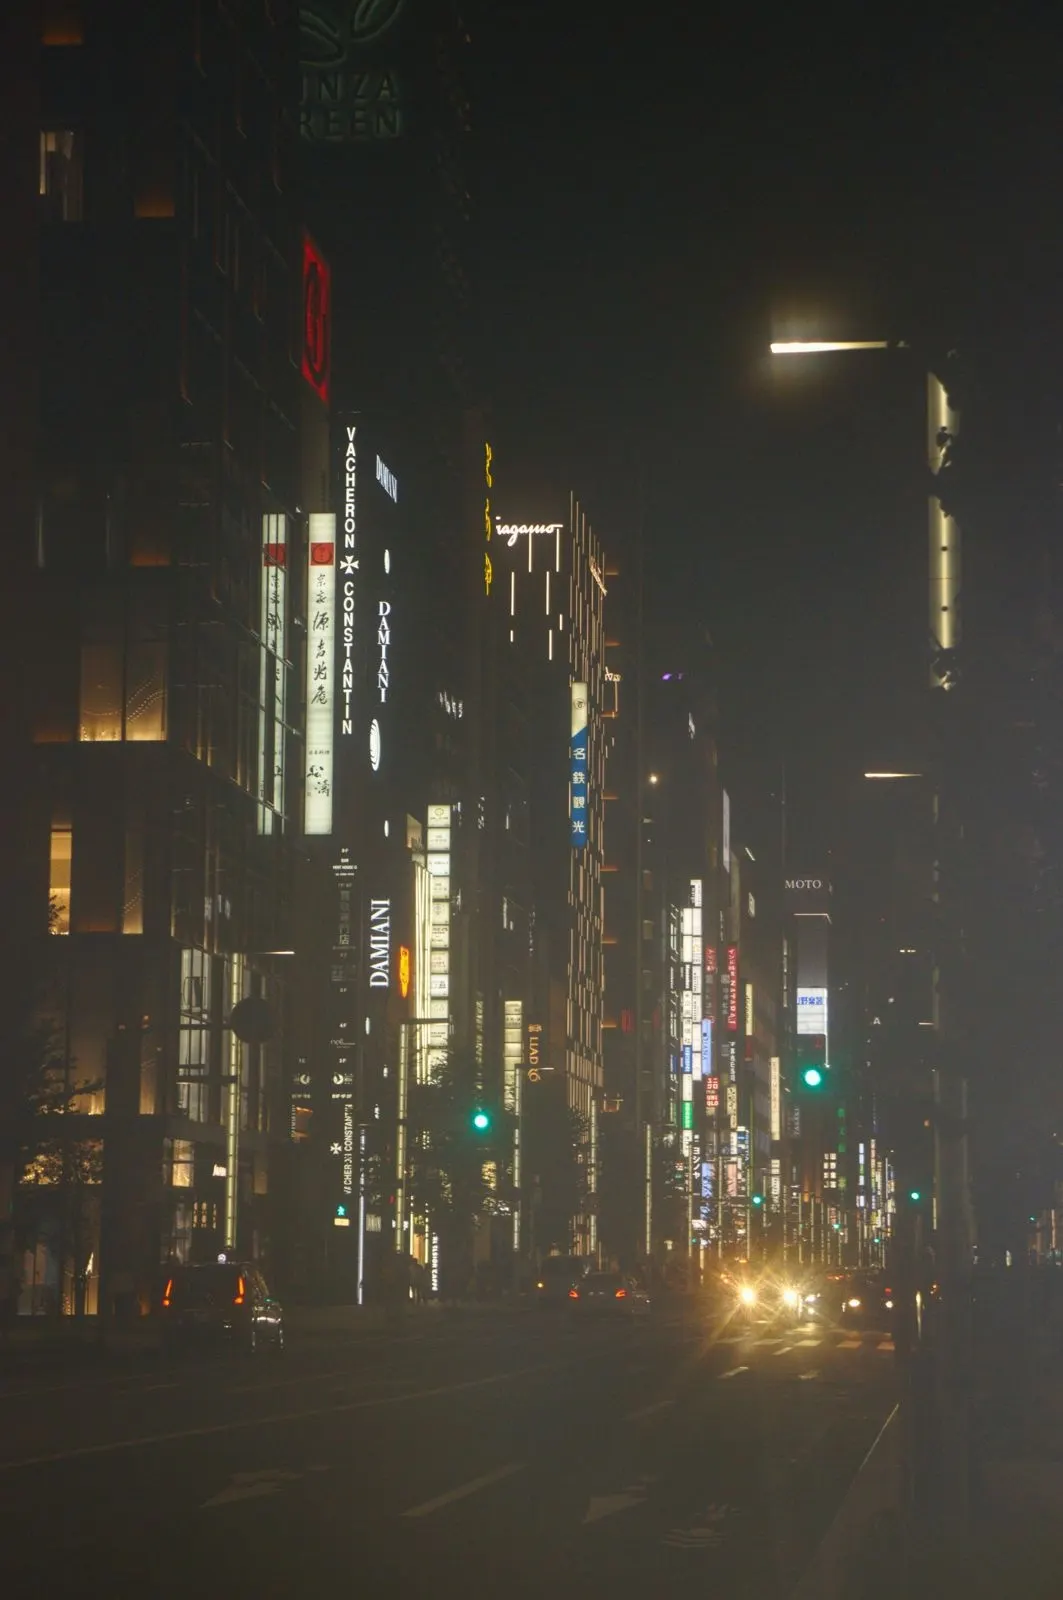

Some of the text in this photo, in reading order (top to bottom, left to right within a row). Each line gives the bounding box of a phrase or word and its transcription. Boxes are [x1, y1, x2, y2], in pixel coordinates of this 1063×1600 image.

[342, 427, 356, 734] VACHERON CONSTANTIN
[377, 602, 391, 703] DAMIANI
[572, 747, 586, 834] 名鉄観光
[369, 898, 391, 988] DAMIANI
